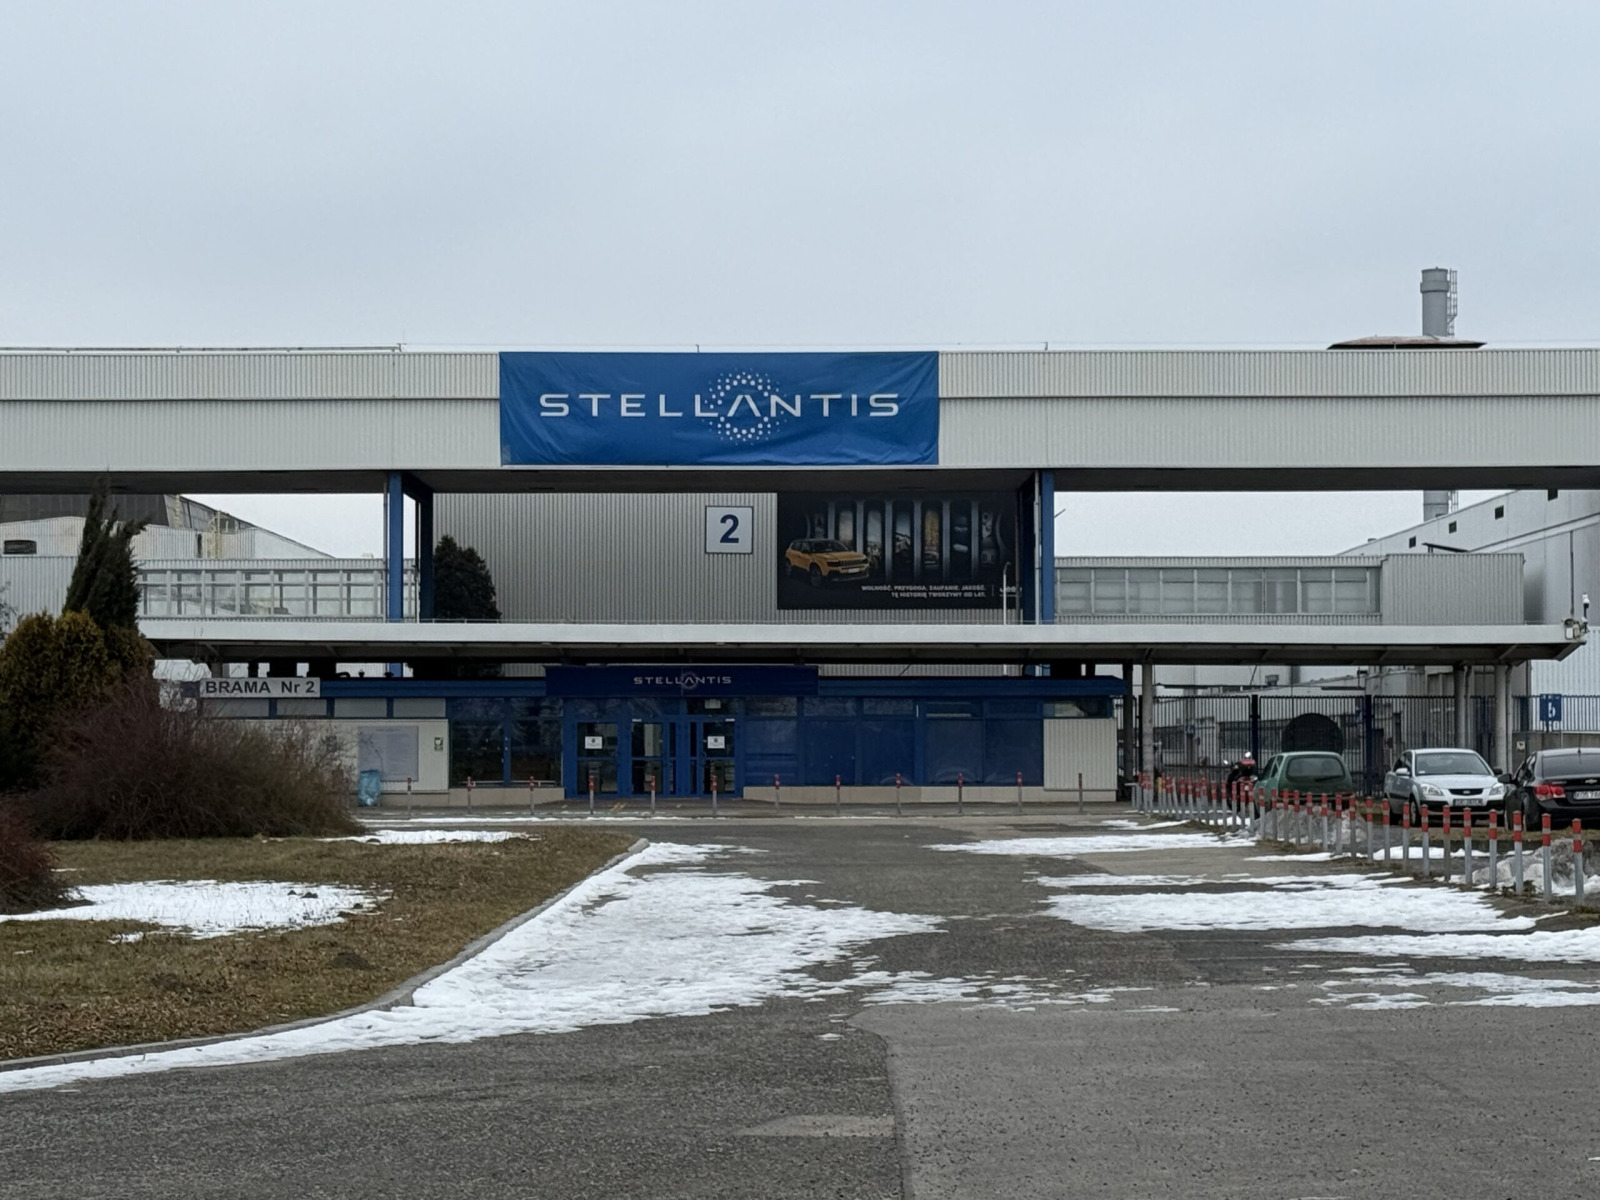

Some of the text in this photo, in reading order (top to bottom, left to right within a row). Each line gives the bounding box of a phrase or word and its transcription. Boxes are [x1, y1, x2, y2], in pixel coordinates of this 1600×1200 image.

[539, 393, 900, 418] STELLANTIS
[719, 513, 740, 544] 2
[205, 681, 315, 694] BRAMA Nr 2
[633, 676, 732, 685] STELLANTIS
